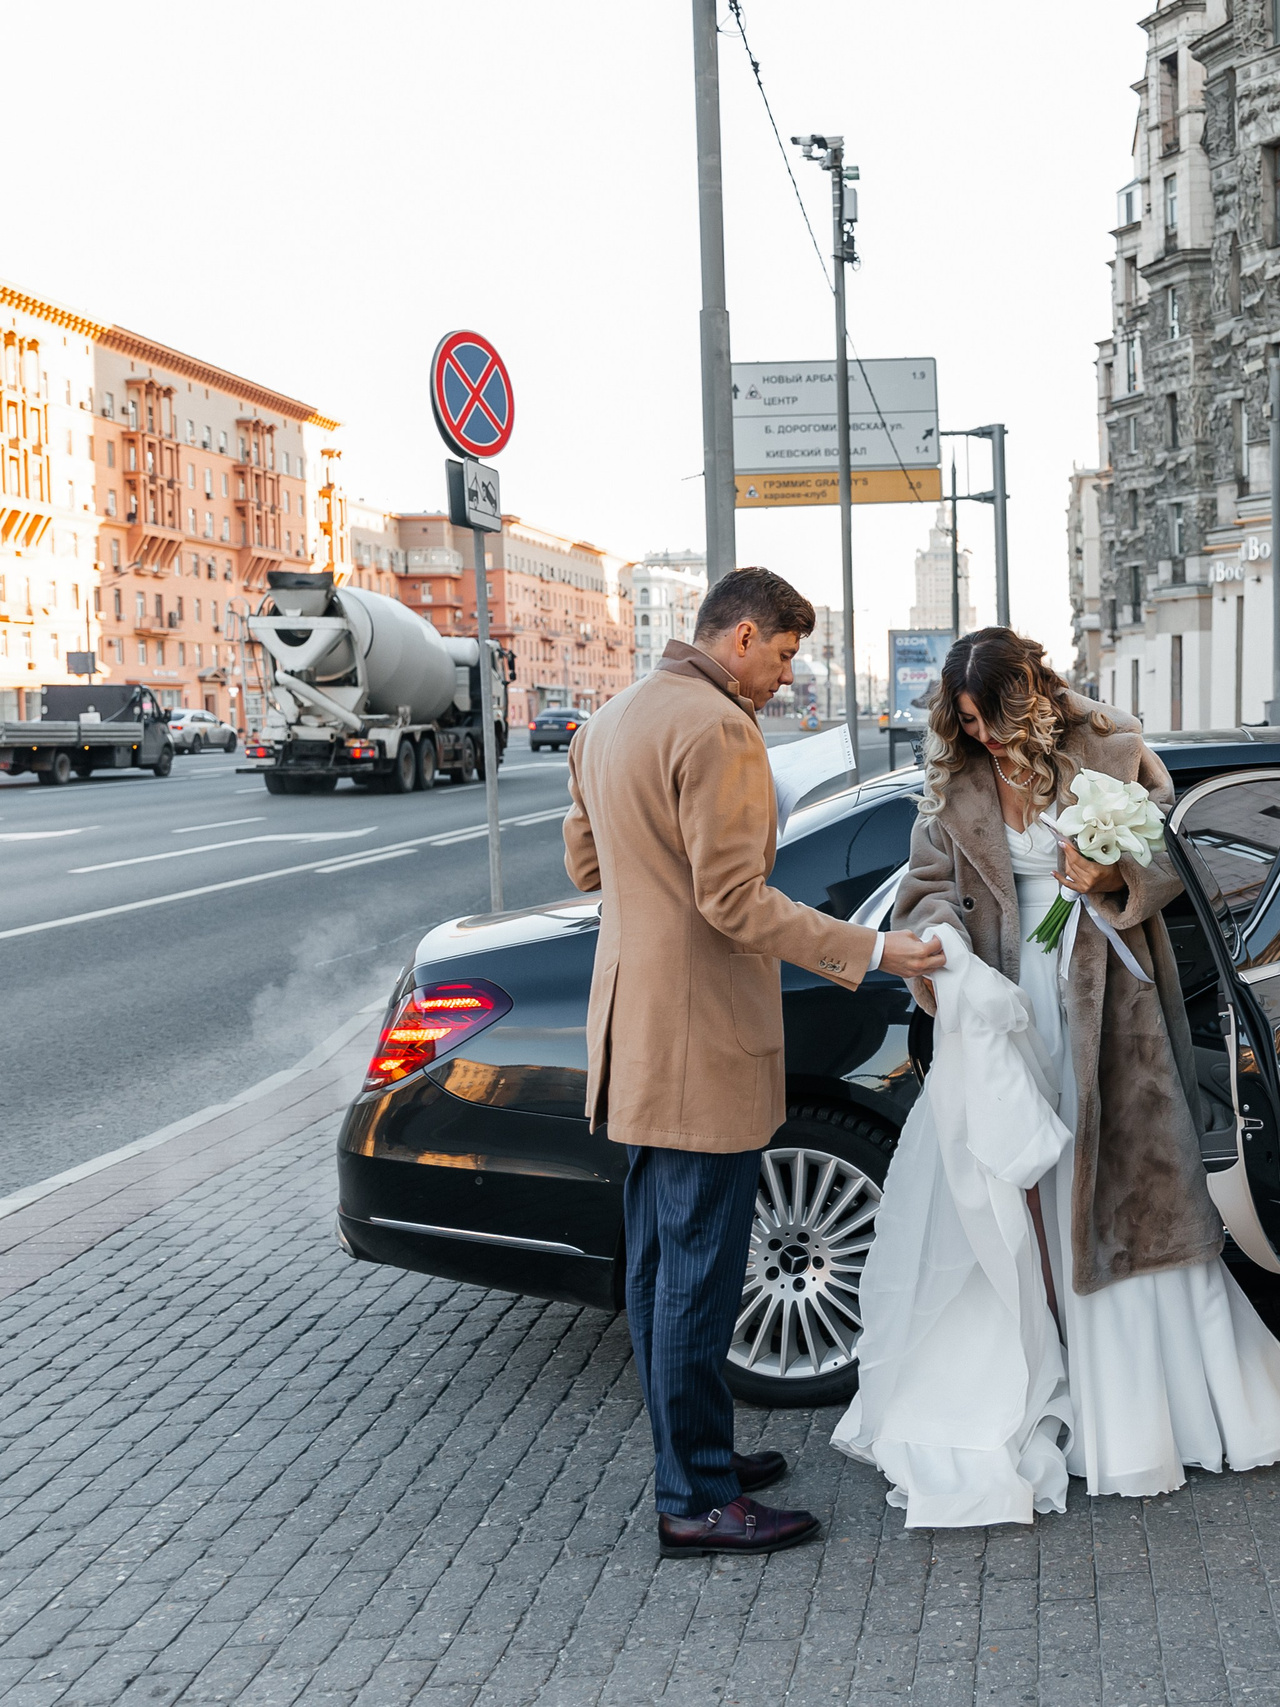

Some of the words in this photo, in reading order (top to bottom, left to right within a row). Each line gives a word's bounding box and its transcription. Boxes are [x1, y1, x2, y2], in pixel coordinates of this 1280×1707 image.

[762, 372, 802, 384] НОВЫЙ
[912, 371, 926, 380] 1.9
[763, 396, 798, 406] ЦЕНТР
[764, 424, 775, 435] Б.
[777, 422, 887, 435] ДОРОГОМИВСКАЯ
[765, 448, 821, 459] КИЕВСКИЙ
[824, 447, 867, 458] ВОАЛ
[815, 477, 869, 488] GRAY'S
[763, 489, 827, 500] караоке-клуб
